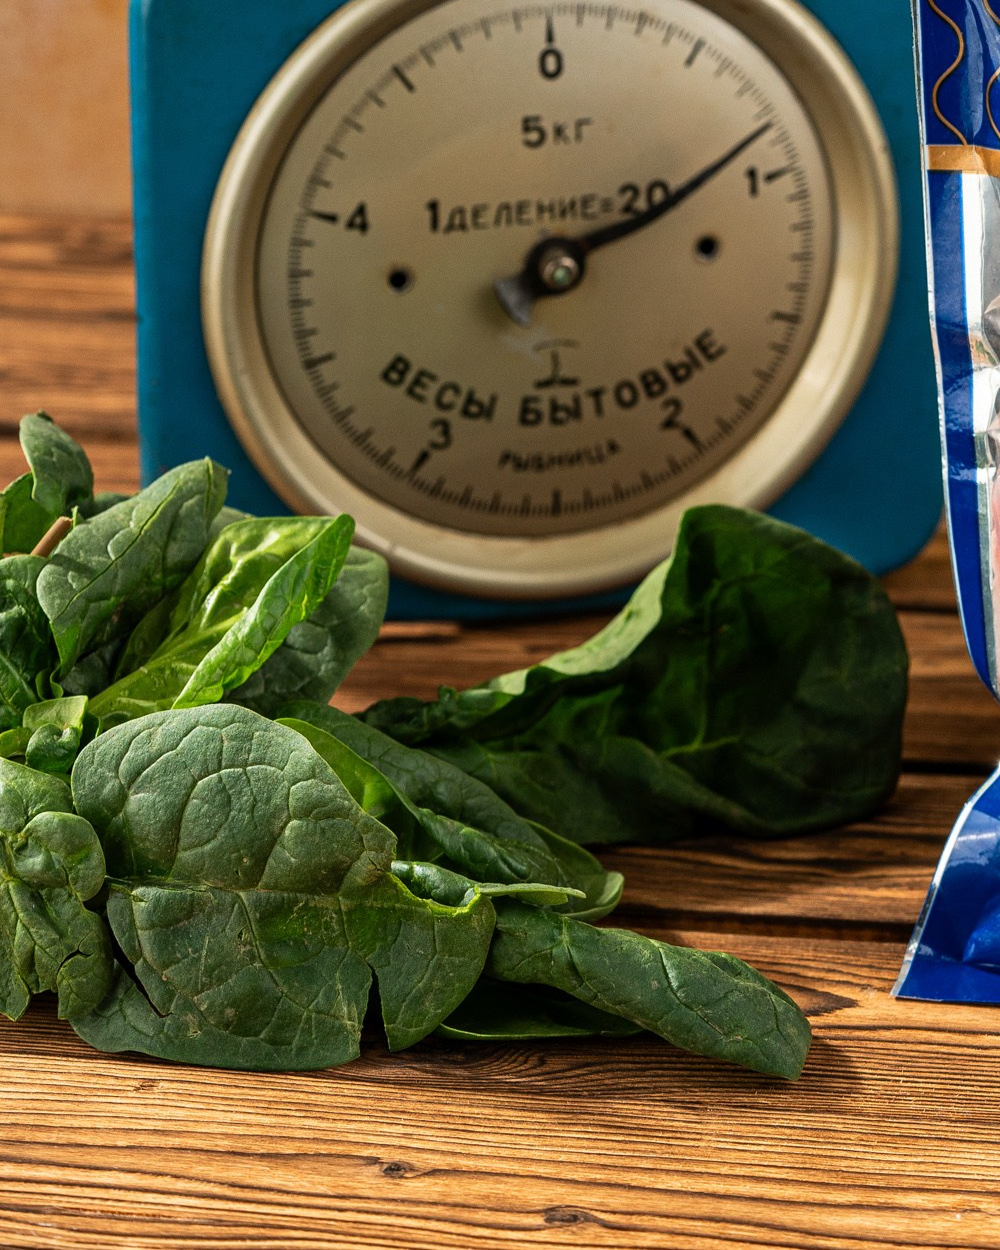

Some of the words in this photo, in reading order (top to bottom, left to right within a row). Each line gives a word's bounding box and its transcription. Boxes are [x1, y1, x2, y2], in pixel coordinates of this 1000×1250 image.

[538, 47, 564, 80] 0
[745, 166, 762, 197] 1
[344, 202, 370, 236] 4
[379, 353, 498, 423] ВЕСЫ
[518, 327, 729, 428] БЫТОВЫЕ
[659, 398, 684, 432] 2
[428, 417, 454, 451] 3
